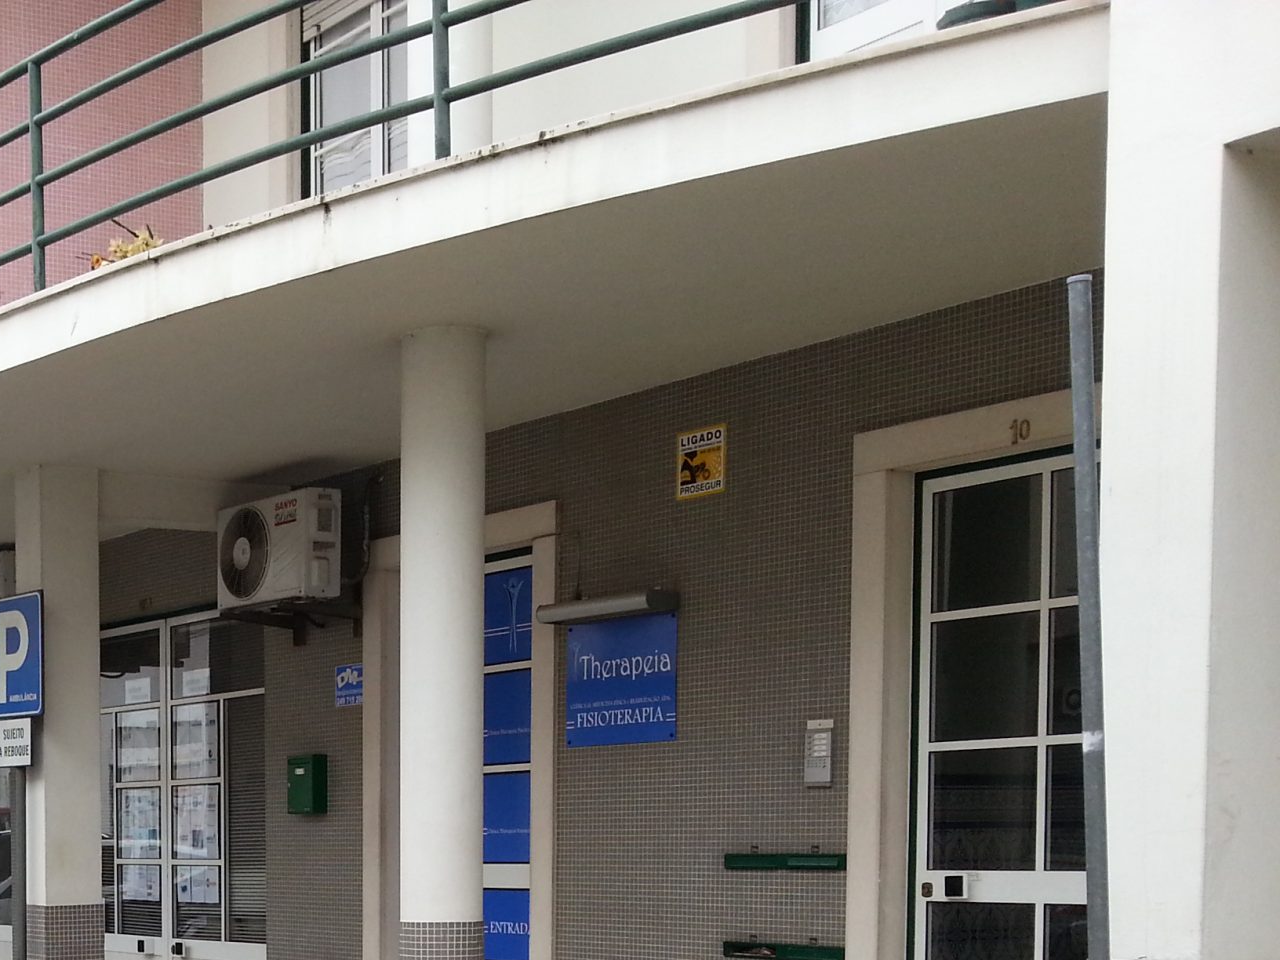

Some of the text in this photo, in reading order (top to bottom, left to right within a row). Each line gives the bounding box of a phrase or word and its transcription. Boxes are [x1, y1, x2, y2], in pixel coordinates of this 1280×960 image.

[680, 429, 722, 448] LIGADO
[680, 480, 722, 495] PROSEGUR
[274, 498, 298, 512] SANYO
[579, 650, 671, 680] Therapeia
[577, 706, 664, 728] FISIOTERAPIA
[3, 727, 24, 741] SUJEITO
[4, 744, 29, 758] REBOQUE
[490, 921, 530, 935] ENTRAD
